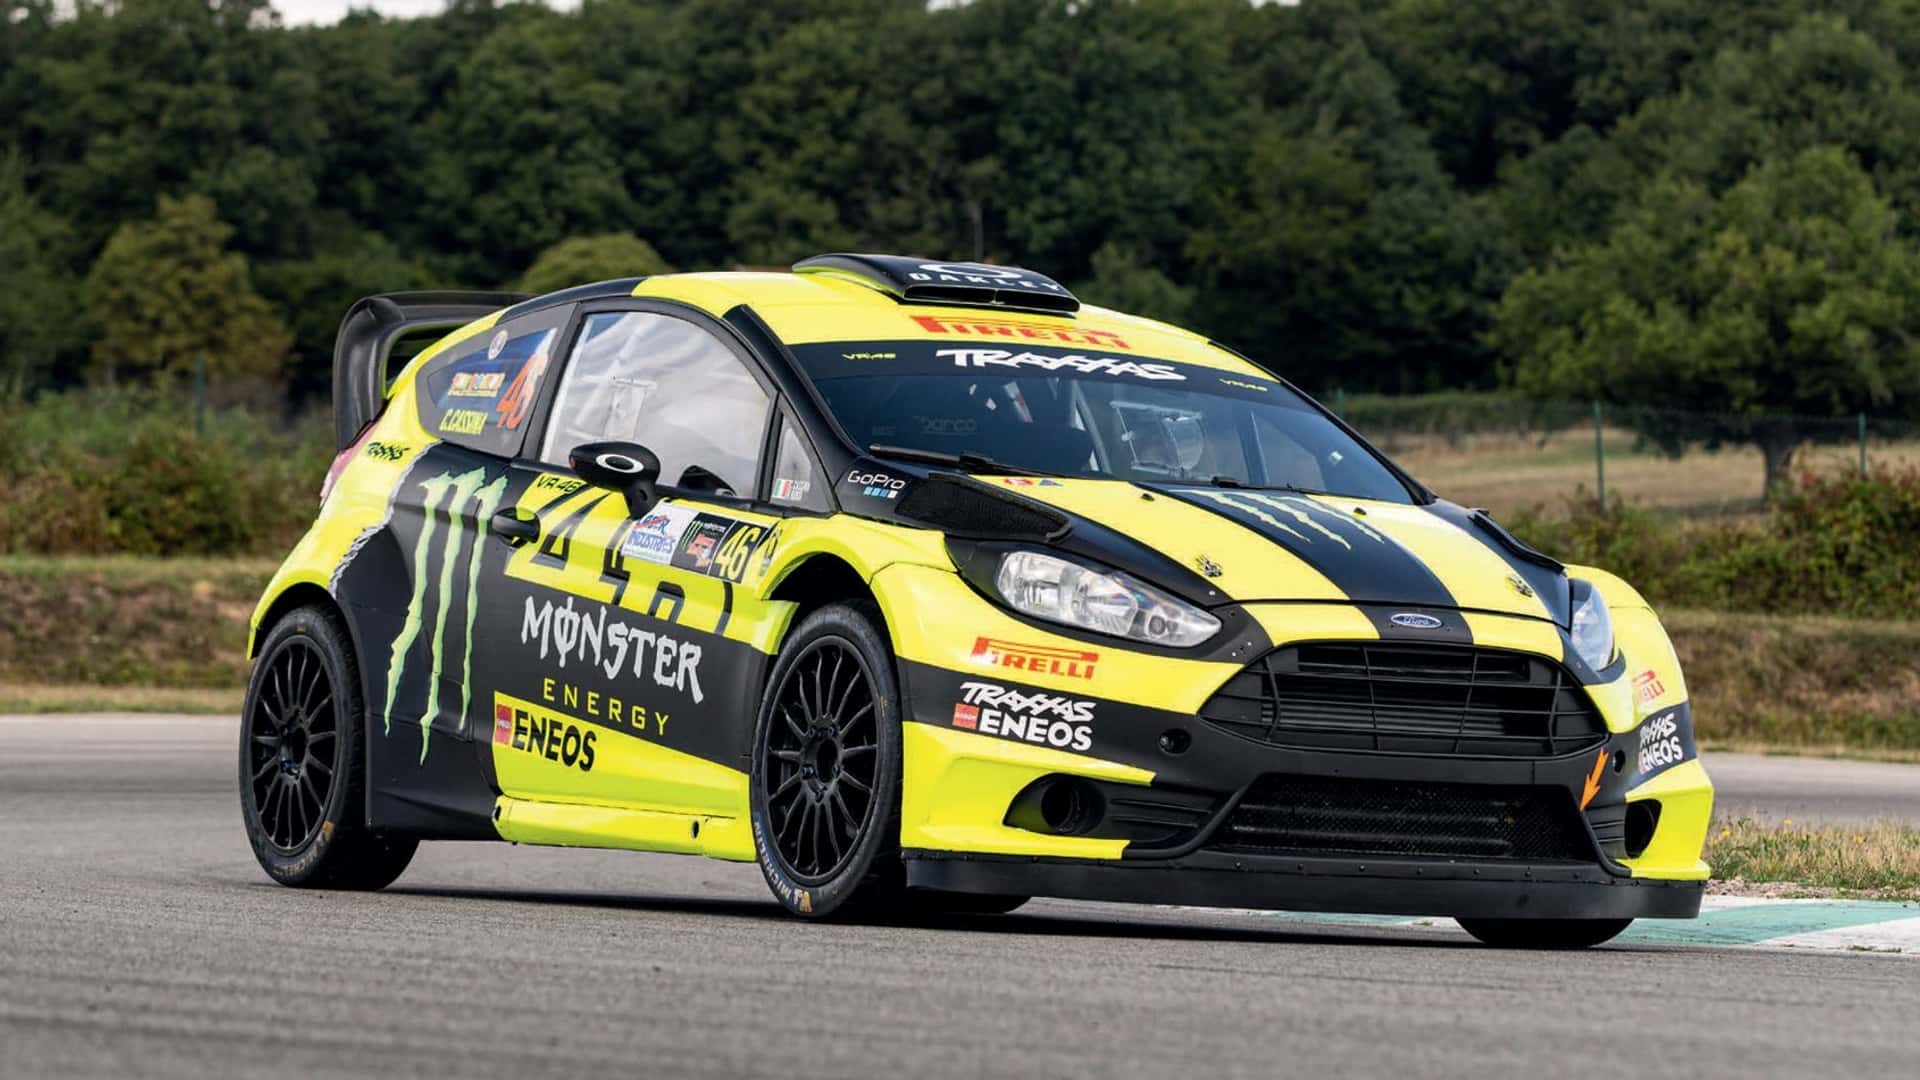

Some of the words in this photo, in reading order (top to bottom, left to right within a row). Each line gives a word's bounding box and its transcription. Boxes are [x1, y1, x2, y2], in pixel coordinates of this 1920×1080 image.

[908, 272, 1060, 291] OAKLEY
[909, 315, 1131, 350] PIRELLI
[935, 349, 1187, 382] TRAXXAS
[535, 475, 585, 495] VR46
[847, 470, 906, 489] GoPro
[715, 524, 761, 581] 46
[543, 678, 669, 736] ENERGY
[960, 681, 1097, 722] TRAXXAS
[512, 708, 597, 772] ENEOS
[979, 708, 1093, 751] ENEOS
